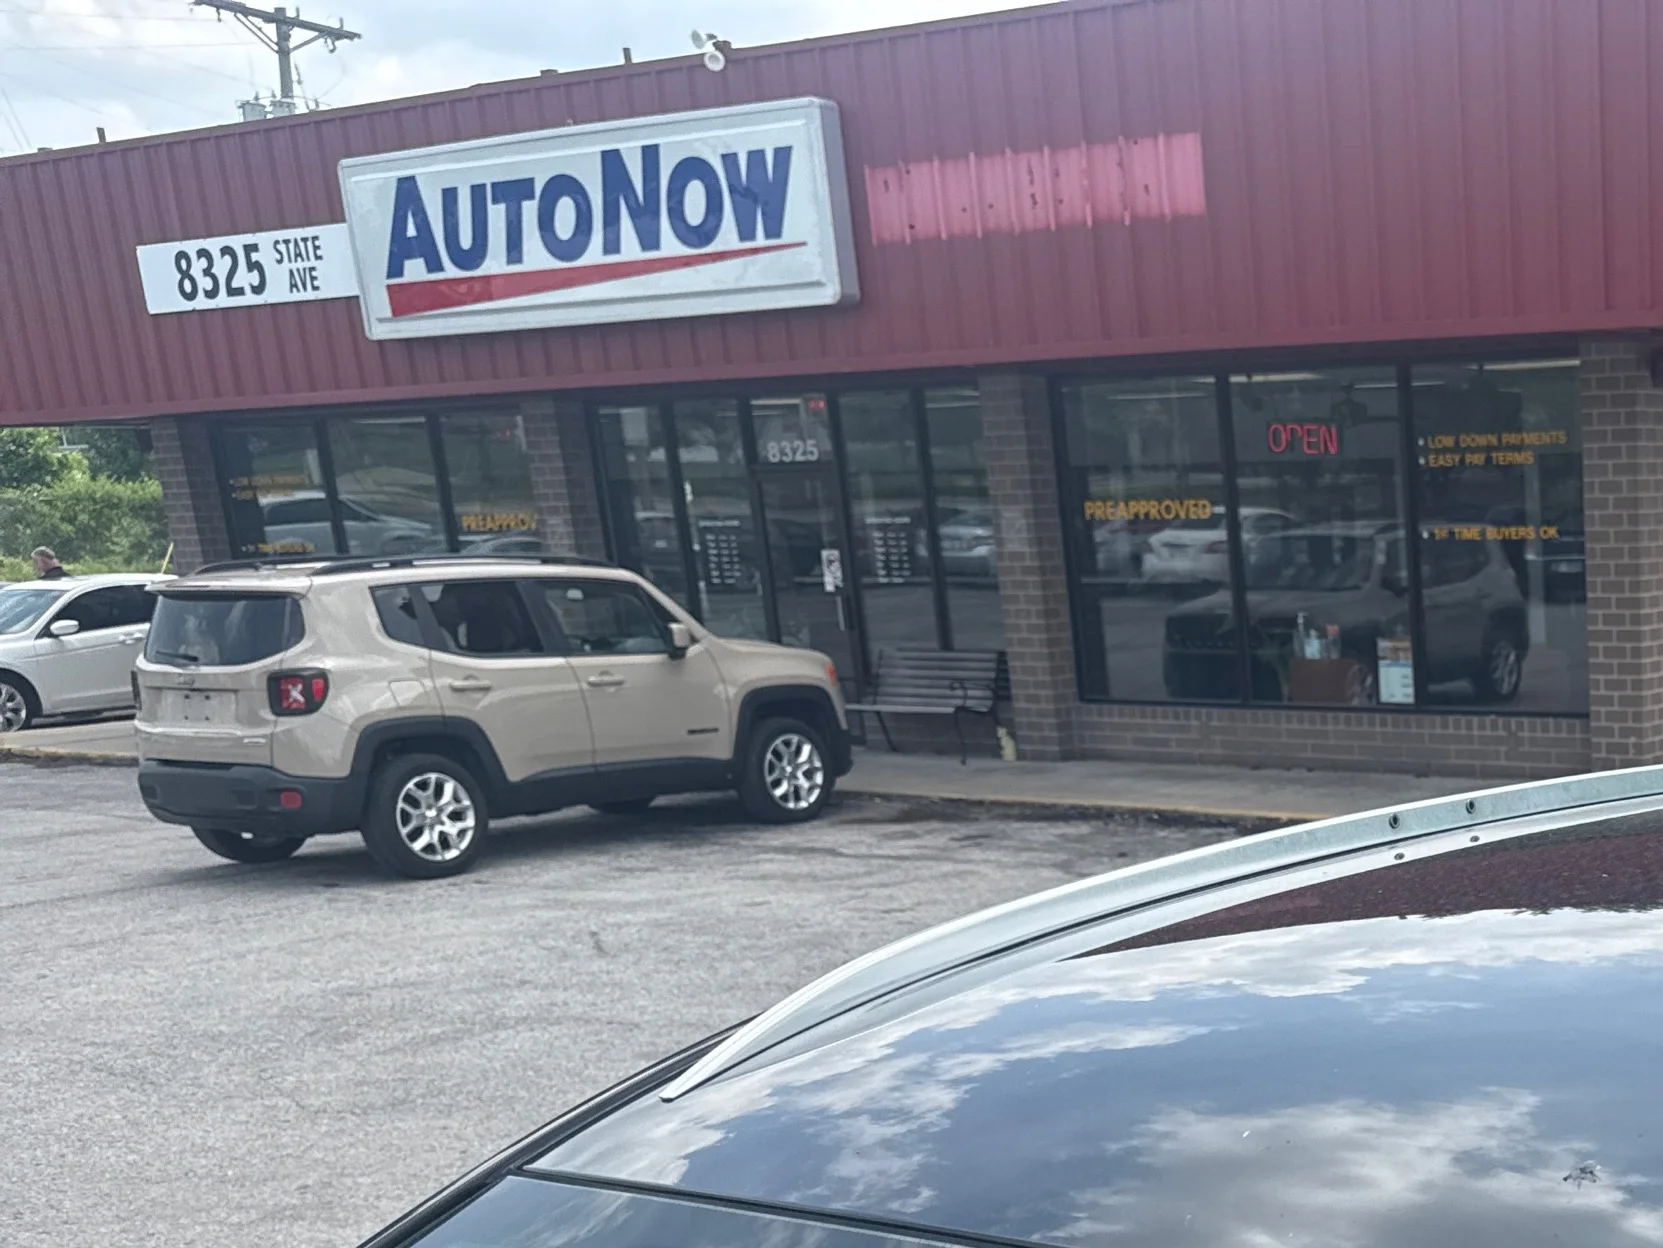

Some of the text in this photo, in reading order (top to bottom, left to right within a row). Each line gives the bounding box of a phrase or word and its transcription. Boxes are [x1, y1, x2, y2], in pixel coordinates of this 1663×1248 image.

[273, 236, 323, 264] STATE
[175, 243, 267, 301] 8325
[289, 267, 320, 293] AVE
[1268, 423, 1338, 455] OPEN
[1427, 430, 1567, 448] LOW DOWN PAYMENTS
[767, 440, 819, 463] 8325
[1428, 451, 1534, 467] EASY PAY TERMS
[1084, 499, 1213, 520] PREAPPROVED
[1453, 528, 1481, 540] TIME
[1486, 526, 1536, 540] BUYERS
[1540, 526, 1558, 539] OK
